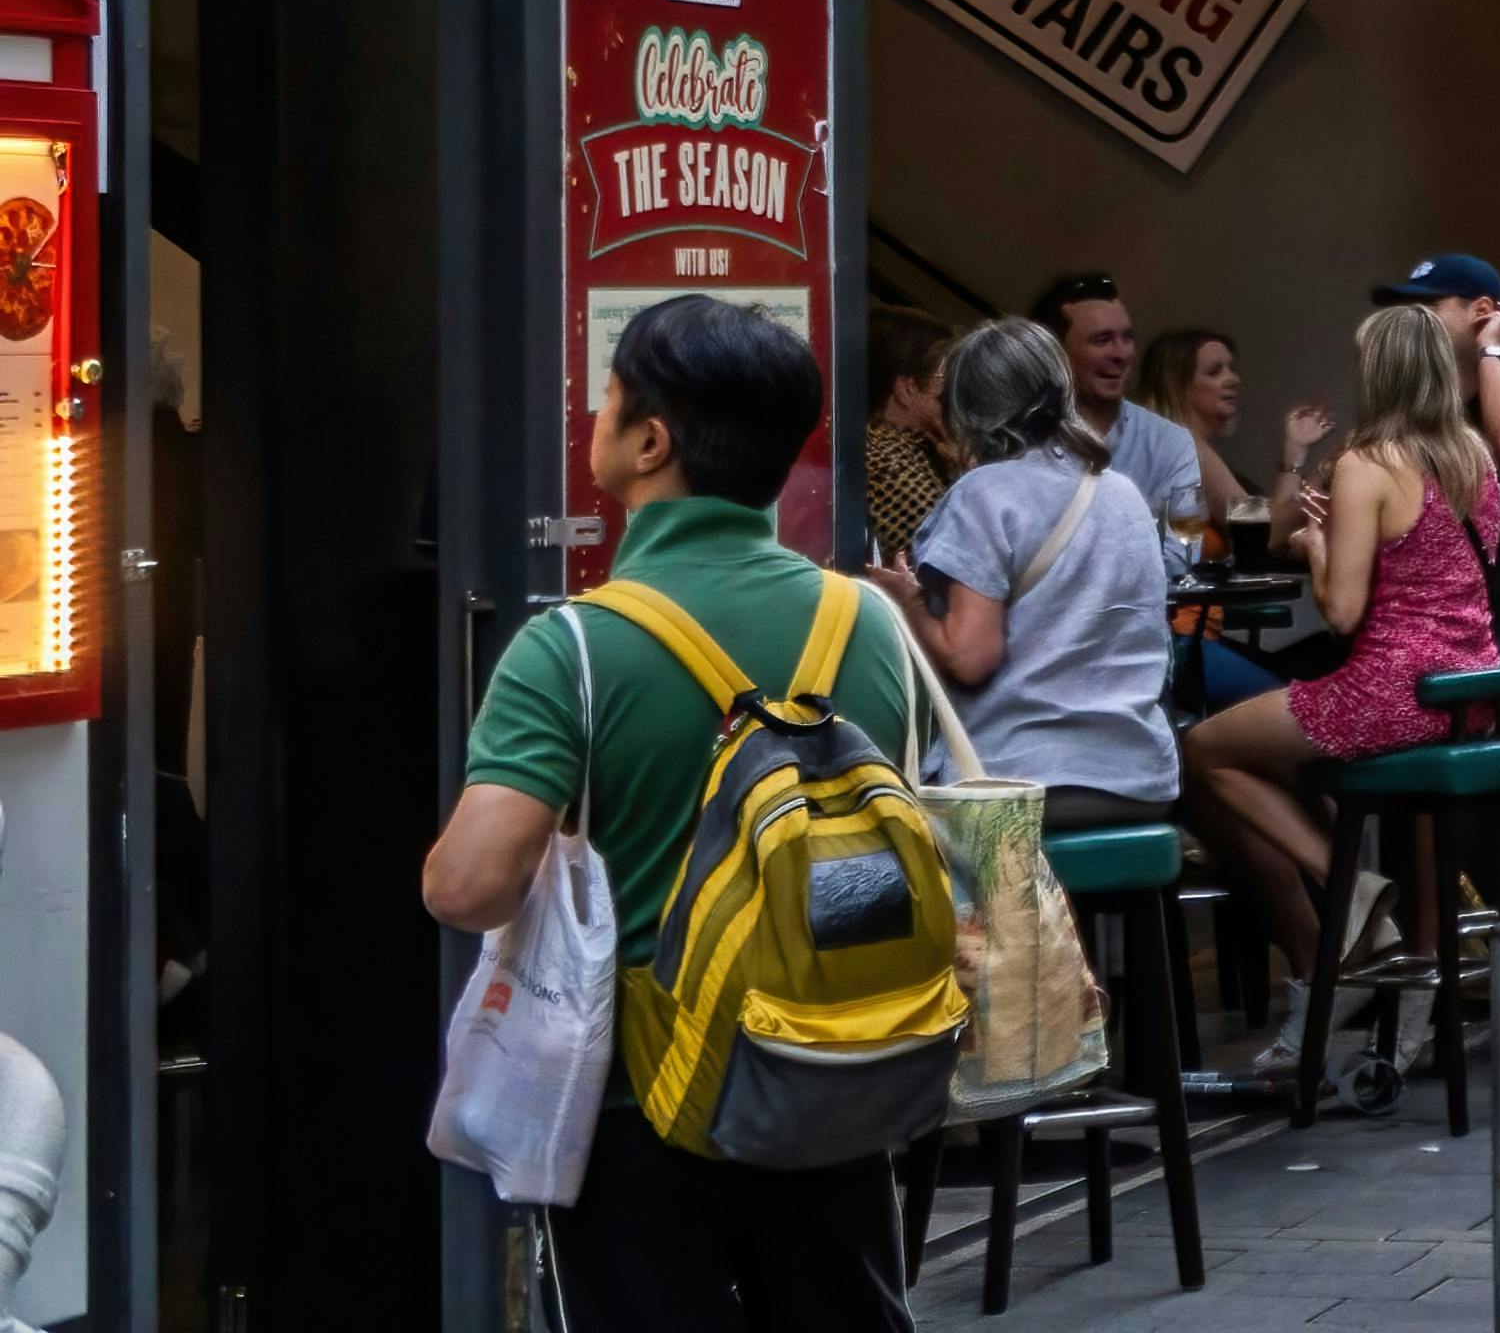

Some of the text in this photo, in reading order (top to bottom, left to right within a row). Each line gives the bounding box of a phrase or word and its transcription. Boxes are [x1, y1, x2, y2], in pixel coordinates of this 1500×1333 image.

[641, 41, 761, 117] Celebrate
[614, 141, 789, 224] THE SEASON
[674, 247, 730, 277] WITH US!
